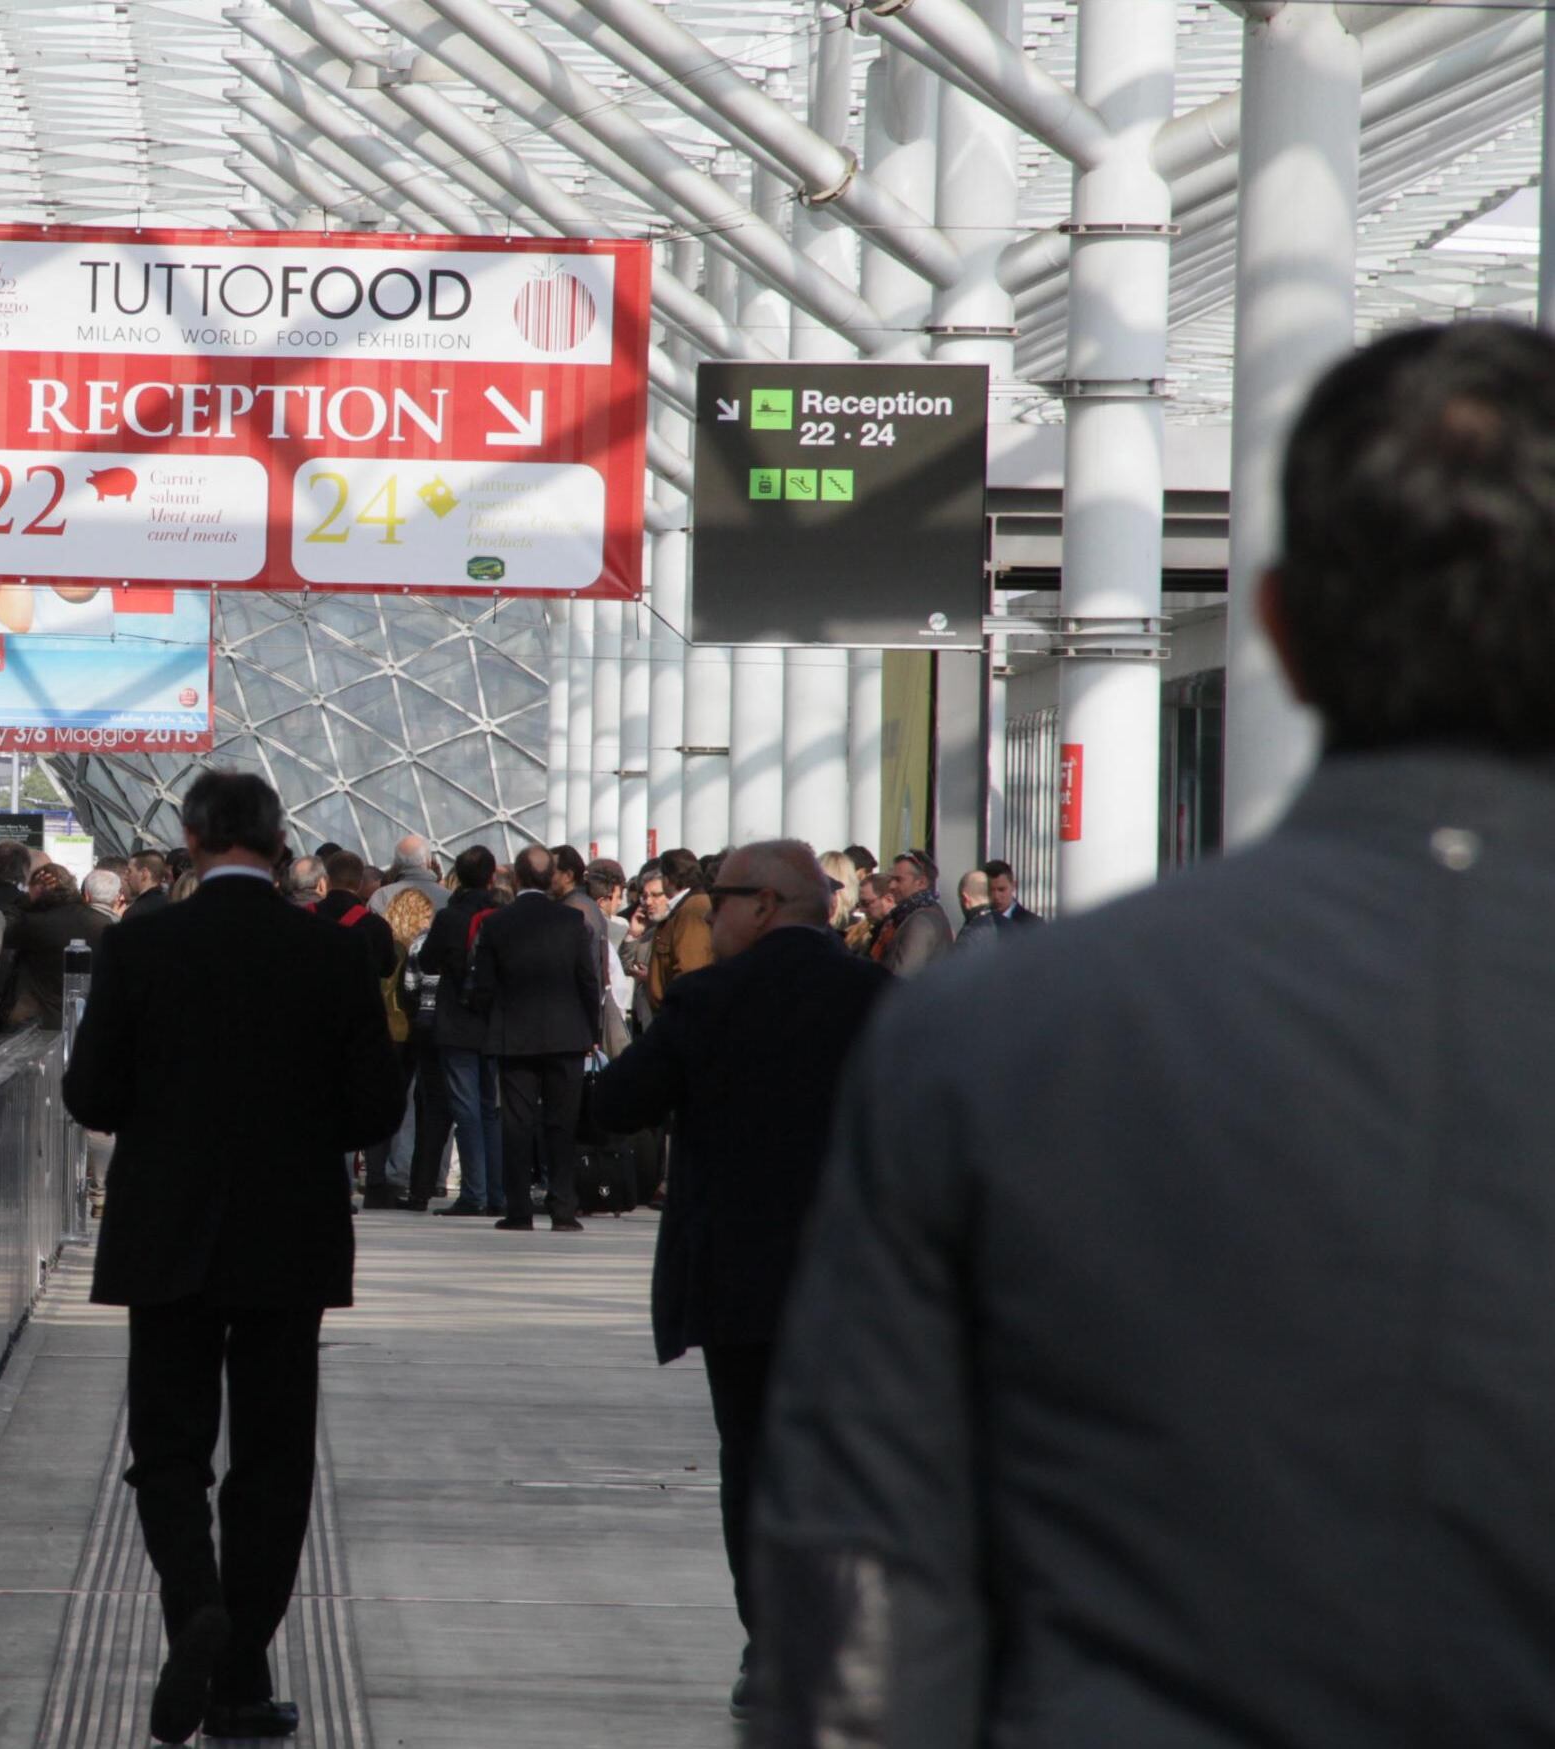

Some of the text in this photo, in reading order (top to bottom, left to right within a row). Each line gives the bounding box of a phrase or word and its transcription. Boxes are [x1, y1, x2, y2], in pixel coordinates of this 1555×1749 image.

[80, 261, 472, 321] TUTTOFOOD
[78, 325, 471, 349] MILANO WORLD FOOD EXHIBITION
[27, 379, 449, 444] RECEPTION
[801, 390, 953, 420] Reception
[799, 422, 836, 446] 22
[860, 423, 896, 446] 24
[150, 469, 193, 487] Carni
[150, 490, 200, 505] salumi
[304, 472, 406, 545] 24
[147, 508, 222, 524] Meat and
[147, 528, 238, 543] cured meats
[14, 727, 47, 744] 3/6
[55, 727, 137, 747] Maggio
